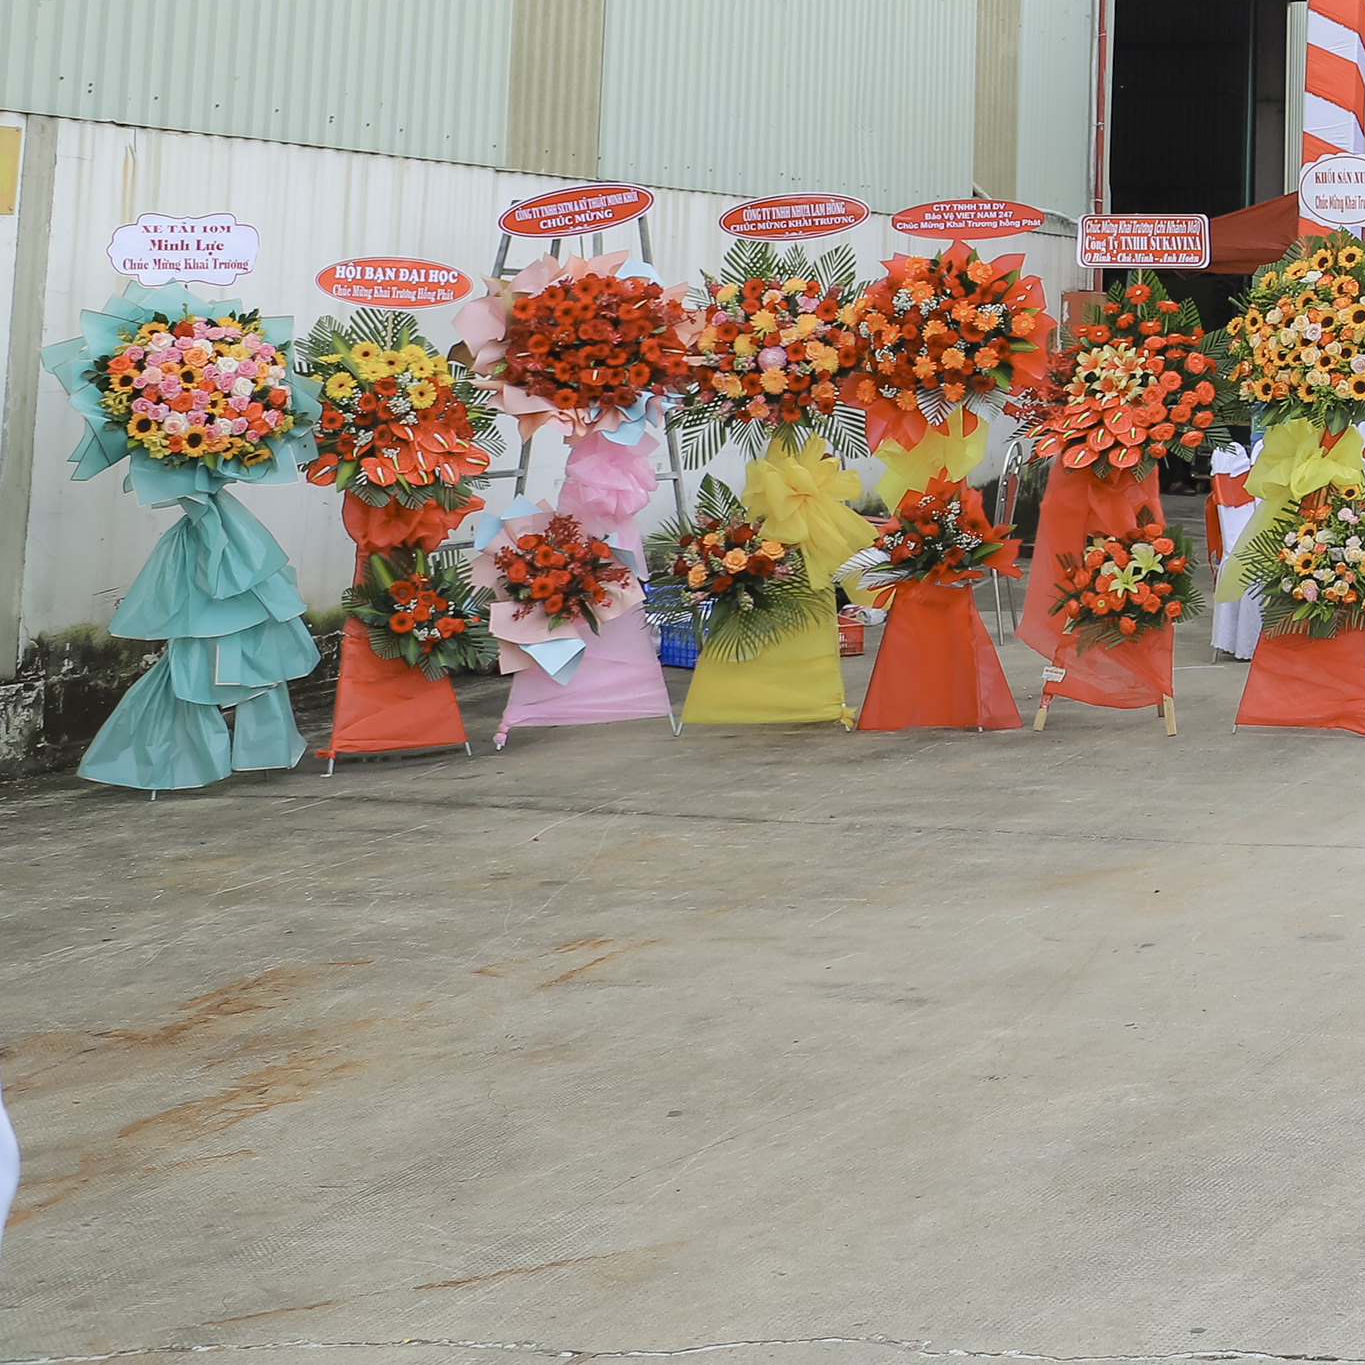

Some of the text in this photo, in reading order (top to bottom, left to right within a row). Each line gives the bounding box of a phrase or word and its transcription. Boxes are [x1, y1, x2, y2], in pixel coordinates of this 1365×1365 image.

[932, 202, 1006, 212] CTY TNHH TM DV
[539, 209, 613, 230] CHÚC MỪNG
[730, 222, 757, 233] CHÚC
[757, 219, 788, 231] MỪNG
[814, 214, 856, 226] TRƯƠNG
[148, 239, 225, 256] Minh Lực
[1085, 235, 1202, 254] Công Ty TNHH SUKAVINA
[122, 258, 249, 273] Chúc Mừng Khai Trương
[334, 262, 459, 286] HỘI BẠN ĐẠI HỌC
